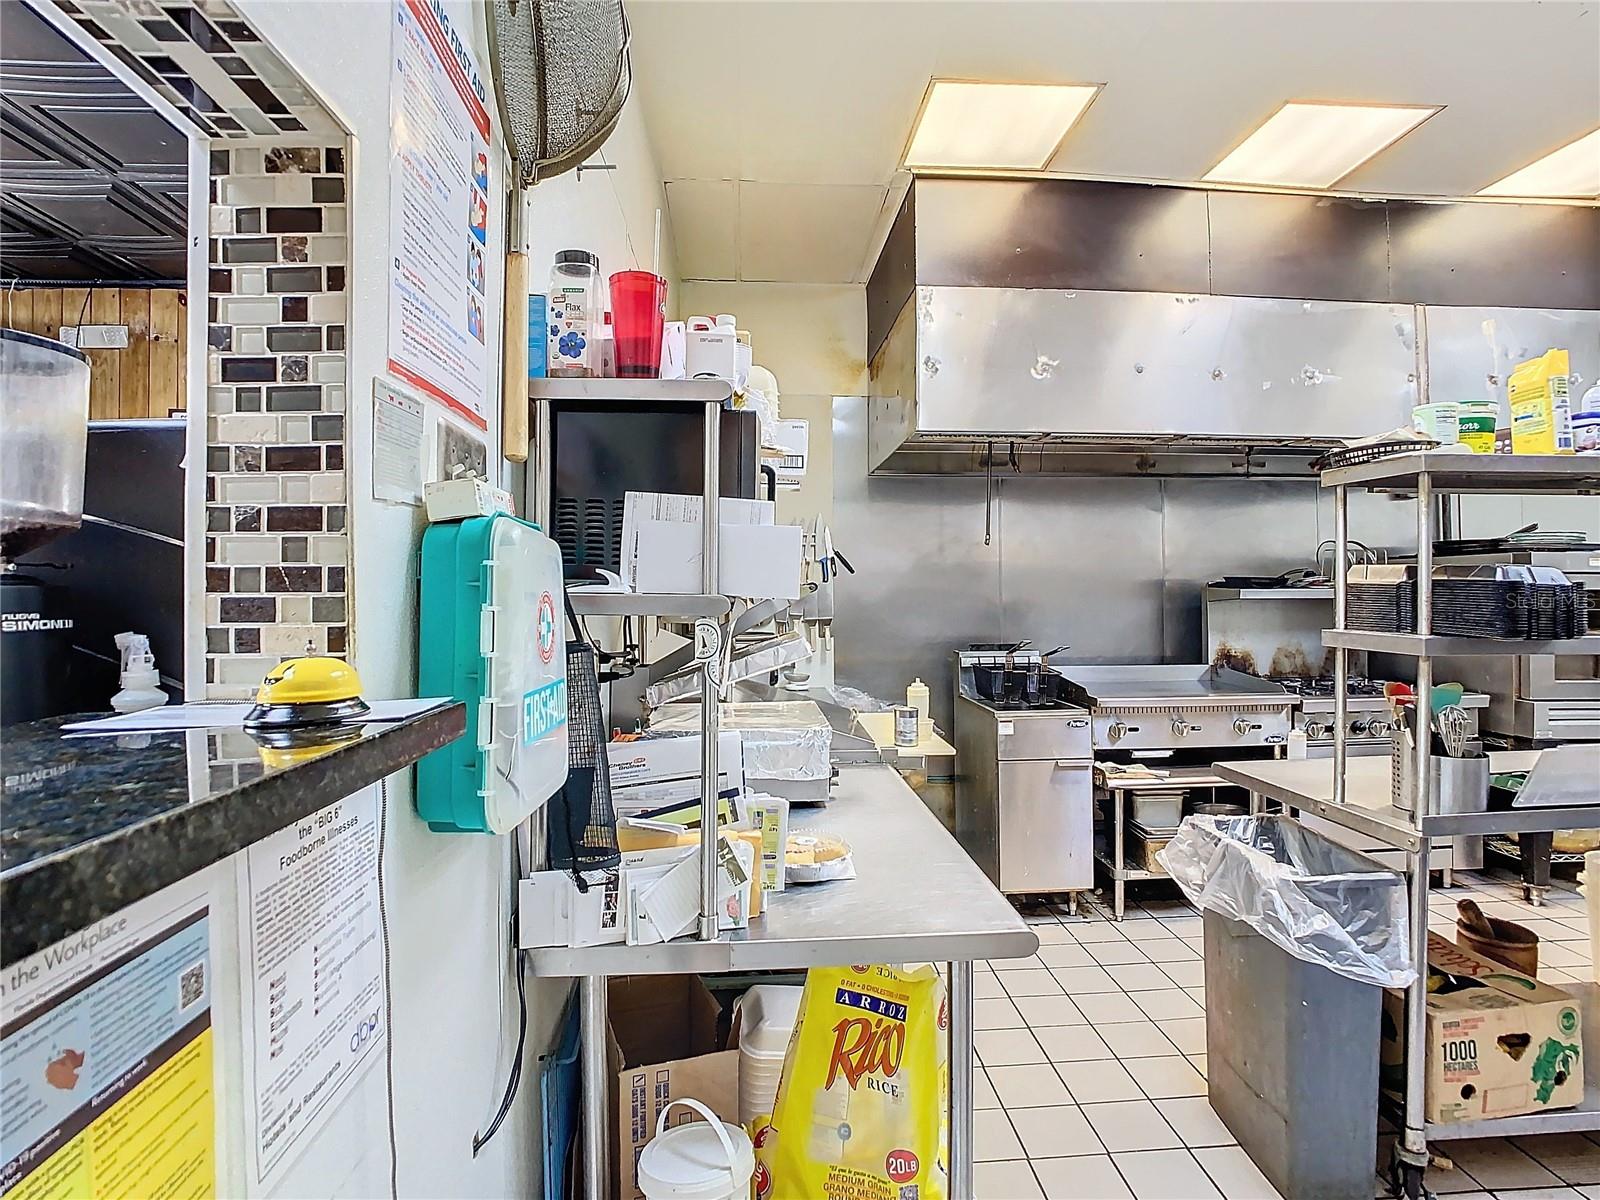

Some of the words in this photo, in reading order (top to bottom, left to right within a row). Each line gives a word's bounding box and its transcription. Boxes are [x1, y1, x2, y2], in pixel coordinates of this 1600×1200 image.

[430, 0, 449, 36] ING
[451, 27, 472, 77] FIRST
[472, 72, 486, 103] AID
[565, 303, 581, 311] Flax
[298, 825, 312, 840] the
[280, 835, 326, 871] Foodborne
[11, 965, 39, 991] the
[44, 917, 127, 970] Workplace
[845, 980, 857, 988] FAT
[839, 991, 906, 1020] ARROZ
[350, 1006, 381, 1052] dbpr
[825, 1017, 906, 1091] Rico
[1441, 1039, 1477, 1062] 1000
[1443, 1060, 1479, 1072] HECTARES
[867, 1076, 899, 1098] RICE
[263, 1123, 287, 1154] Hotels
[289, 1103, 302, 1124] and
[303, 1061, 341, 1106] Restaurants
[823, 1182, 855, 1194] GRANO
[828, 1173, 865, 1187] MEDIUM
[867, 1180, 892, 1196] GRAIN
